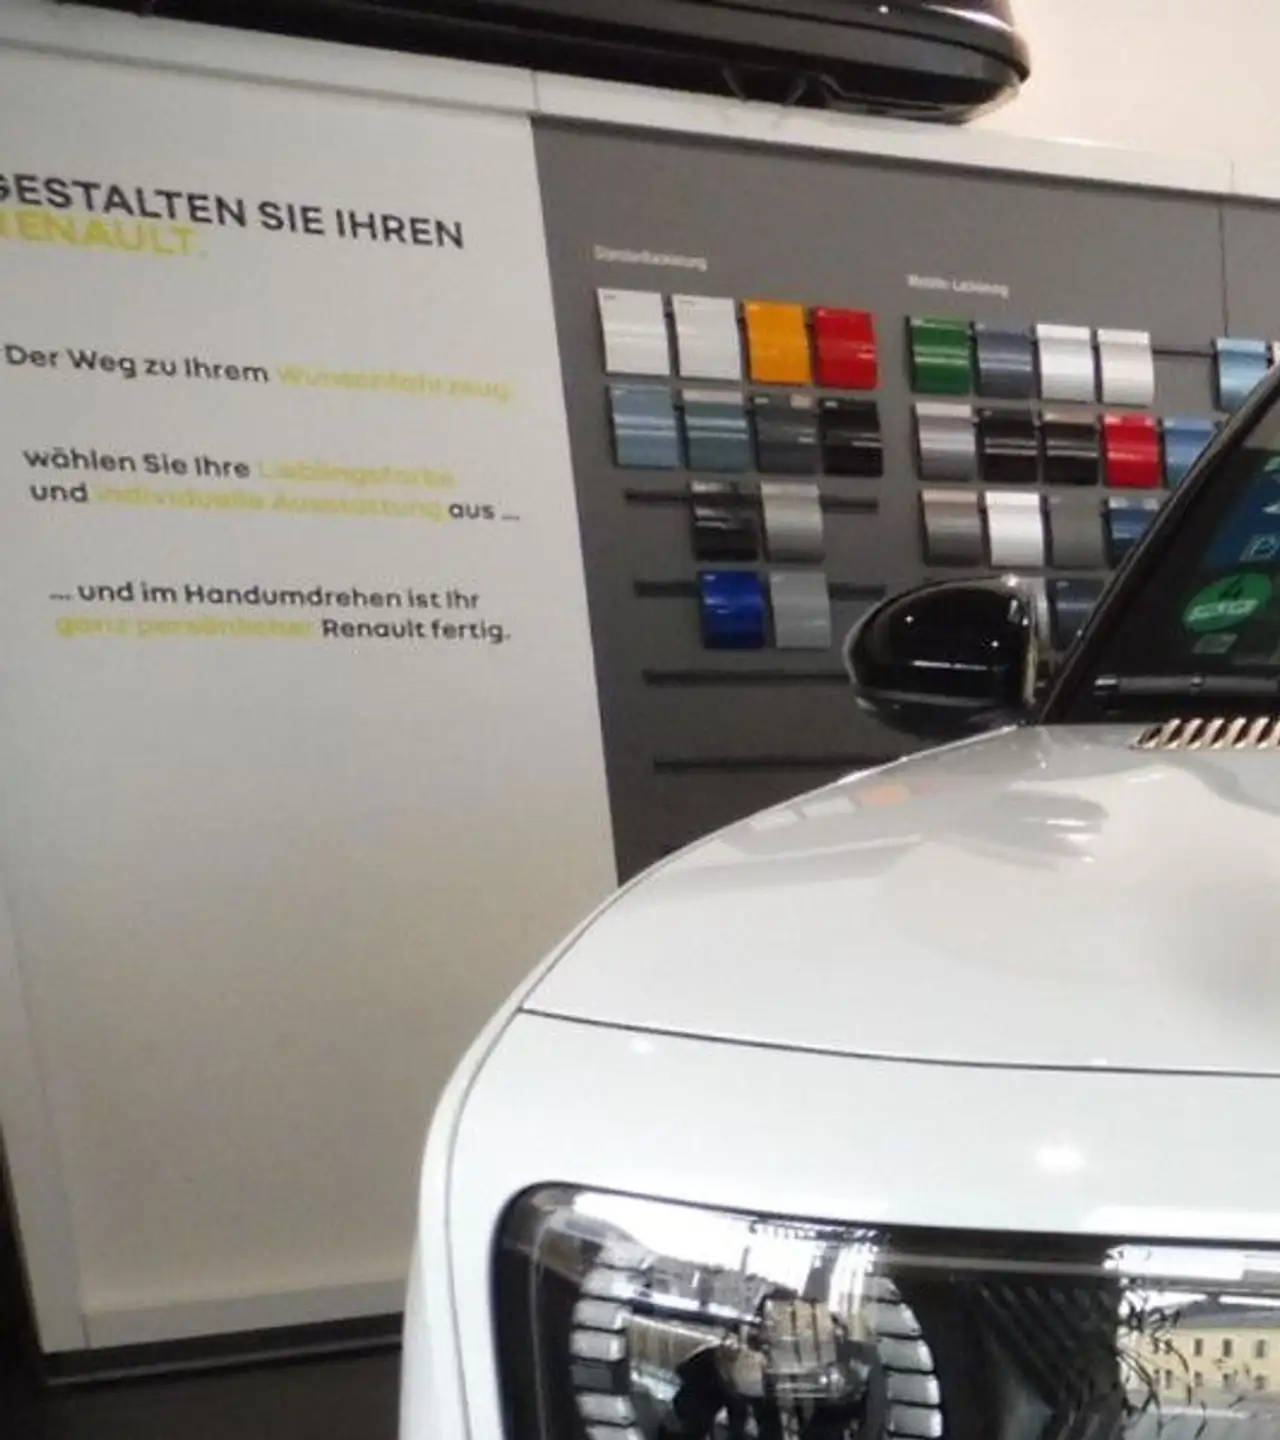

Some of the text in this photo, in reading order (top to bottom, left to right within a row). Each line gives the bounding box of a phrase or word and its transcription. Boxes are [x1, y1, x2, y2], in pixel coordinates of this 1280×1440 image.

[0, 209, 207, 258] ENAULT.
[257, 200, 325, 236] SIE
[335, 208, 465, 250] IHREN
[4, 344, 58, 368] Der
[66, 348, 138, 379] Weg
[143, 358, 177, 377] zu
[184, 356, 270, 383] Ihrem
[22, 446, 137, 472] wählen
[142, 453, 188, 475] Sie
[194, 455, 251, 478] Ihre
[29, 482, 89, 503] und
[448, 503, 496, 520] aus
[77, 580, 133, 602] und
[139, 581, 178, 603] im
[184, 583, 402, 609] Handumdrehen
[407, 588, 442, 609] ist
[446, 588, 480, 609] Ihr
[321, 617, 426, 639] Renault
[431, 617, 512, 644] fertig.
